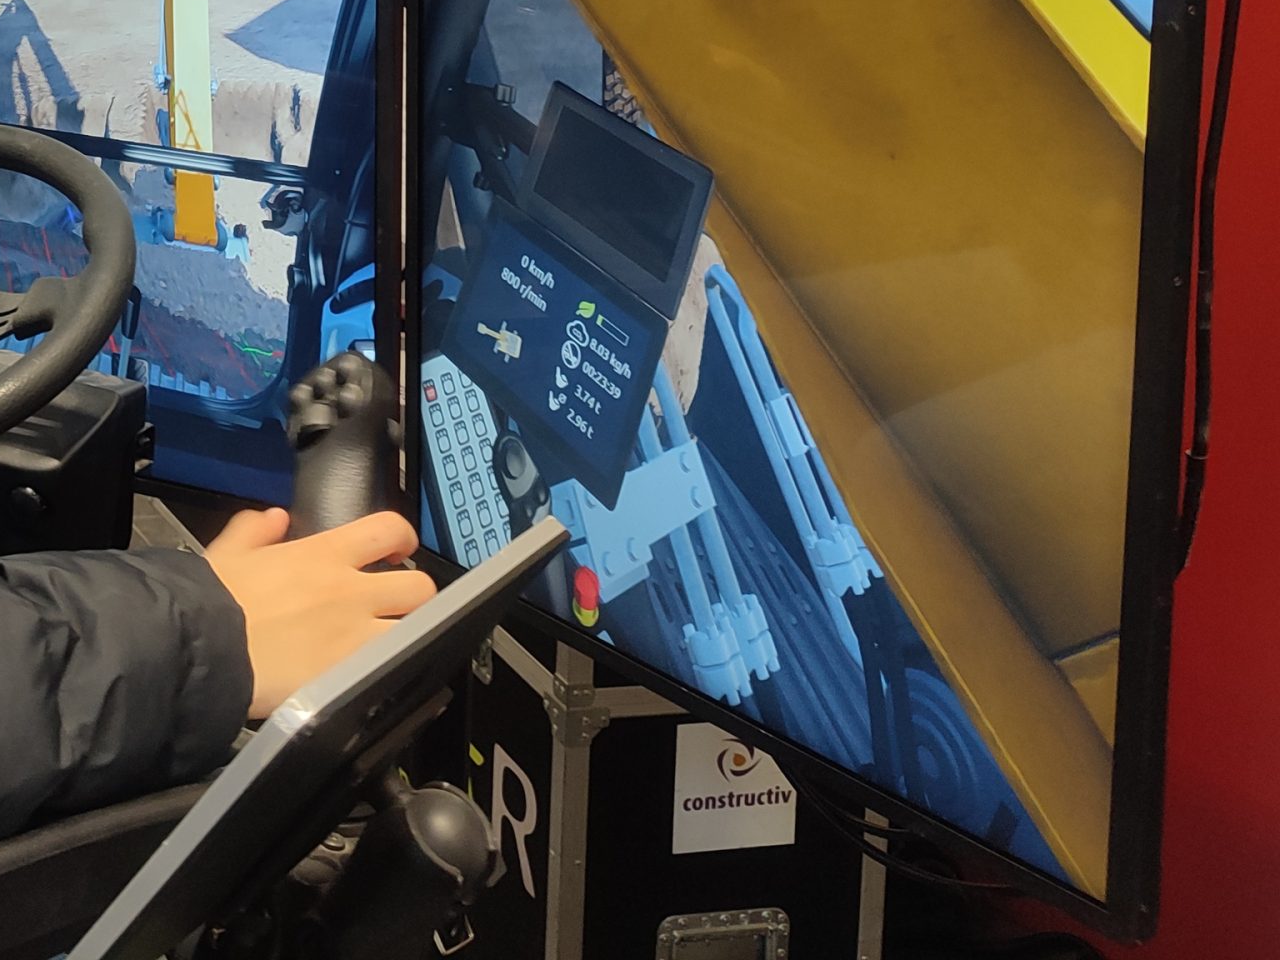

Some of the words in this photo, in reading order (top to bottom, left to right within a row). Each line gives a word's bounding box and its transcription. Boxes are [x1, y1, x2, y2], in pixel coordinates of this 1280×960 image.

[521, 255, 529, 268] 0
[529, 259, 554, 288] km/h
[501, 267, 520, 289] 800
[520, 285, 547, 312] r/min
[610, 353, 631, 379] kg/h
[582, 362, 621, 399] 00:23:39
[595, 402, 601, 414] t
[587, 426, 594, 439] t
[682, 785, 793, 812] constructiv
